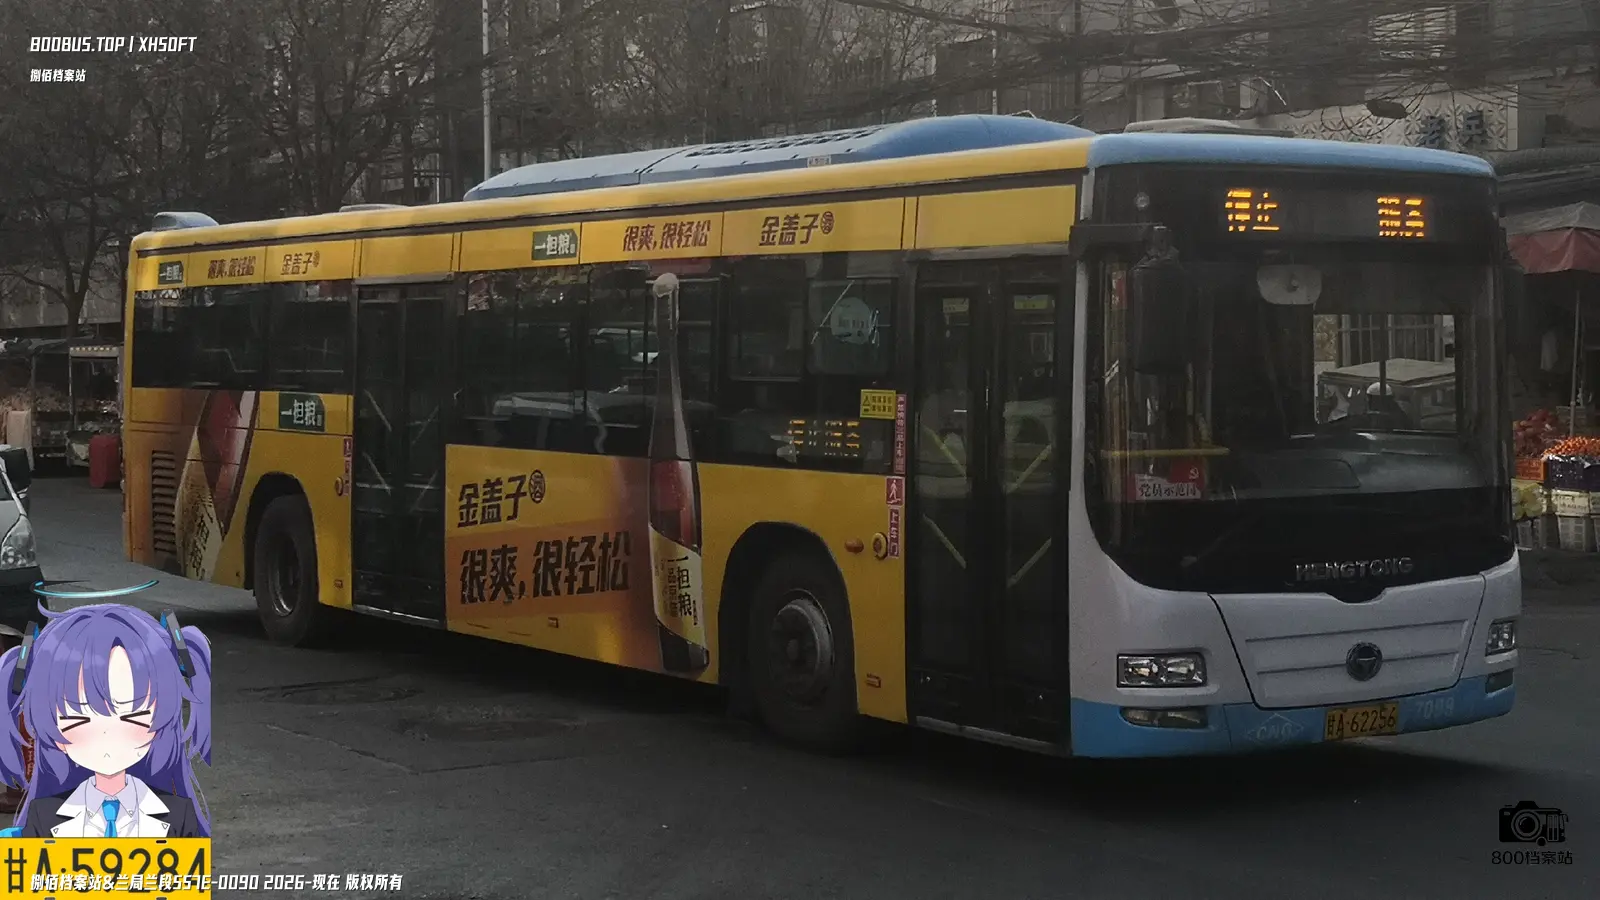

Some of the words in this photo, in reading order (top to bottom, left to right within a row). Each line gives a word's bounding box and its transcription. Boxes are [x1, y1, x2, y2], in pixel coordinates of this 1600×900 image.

[758, 212, 821, 247] 金盖子
[457, 473, 528, 529] 金盖子
[1295, 556, 1414, 582] HENGTONG
